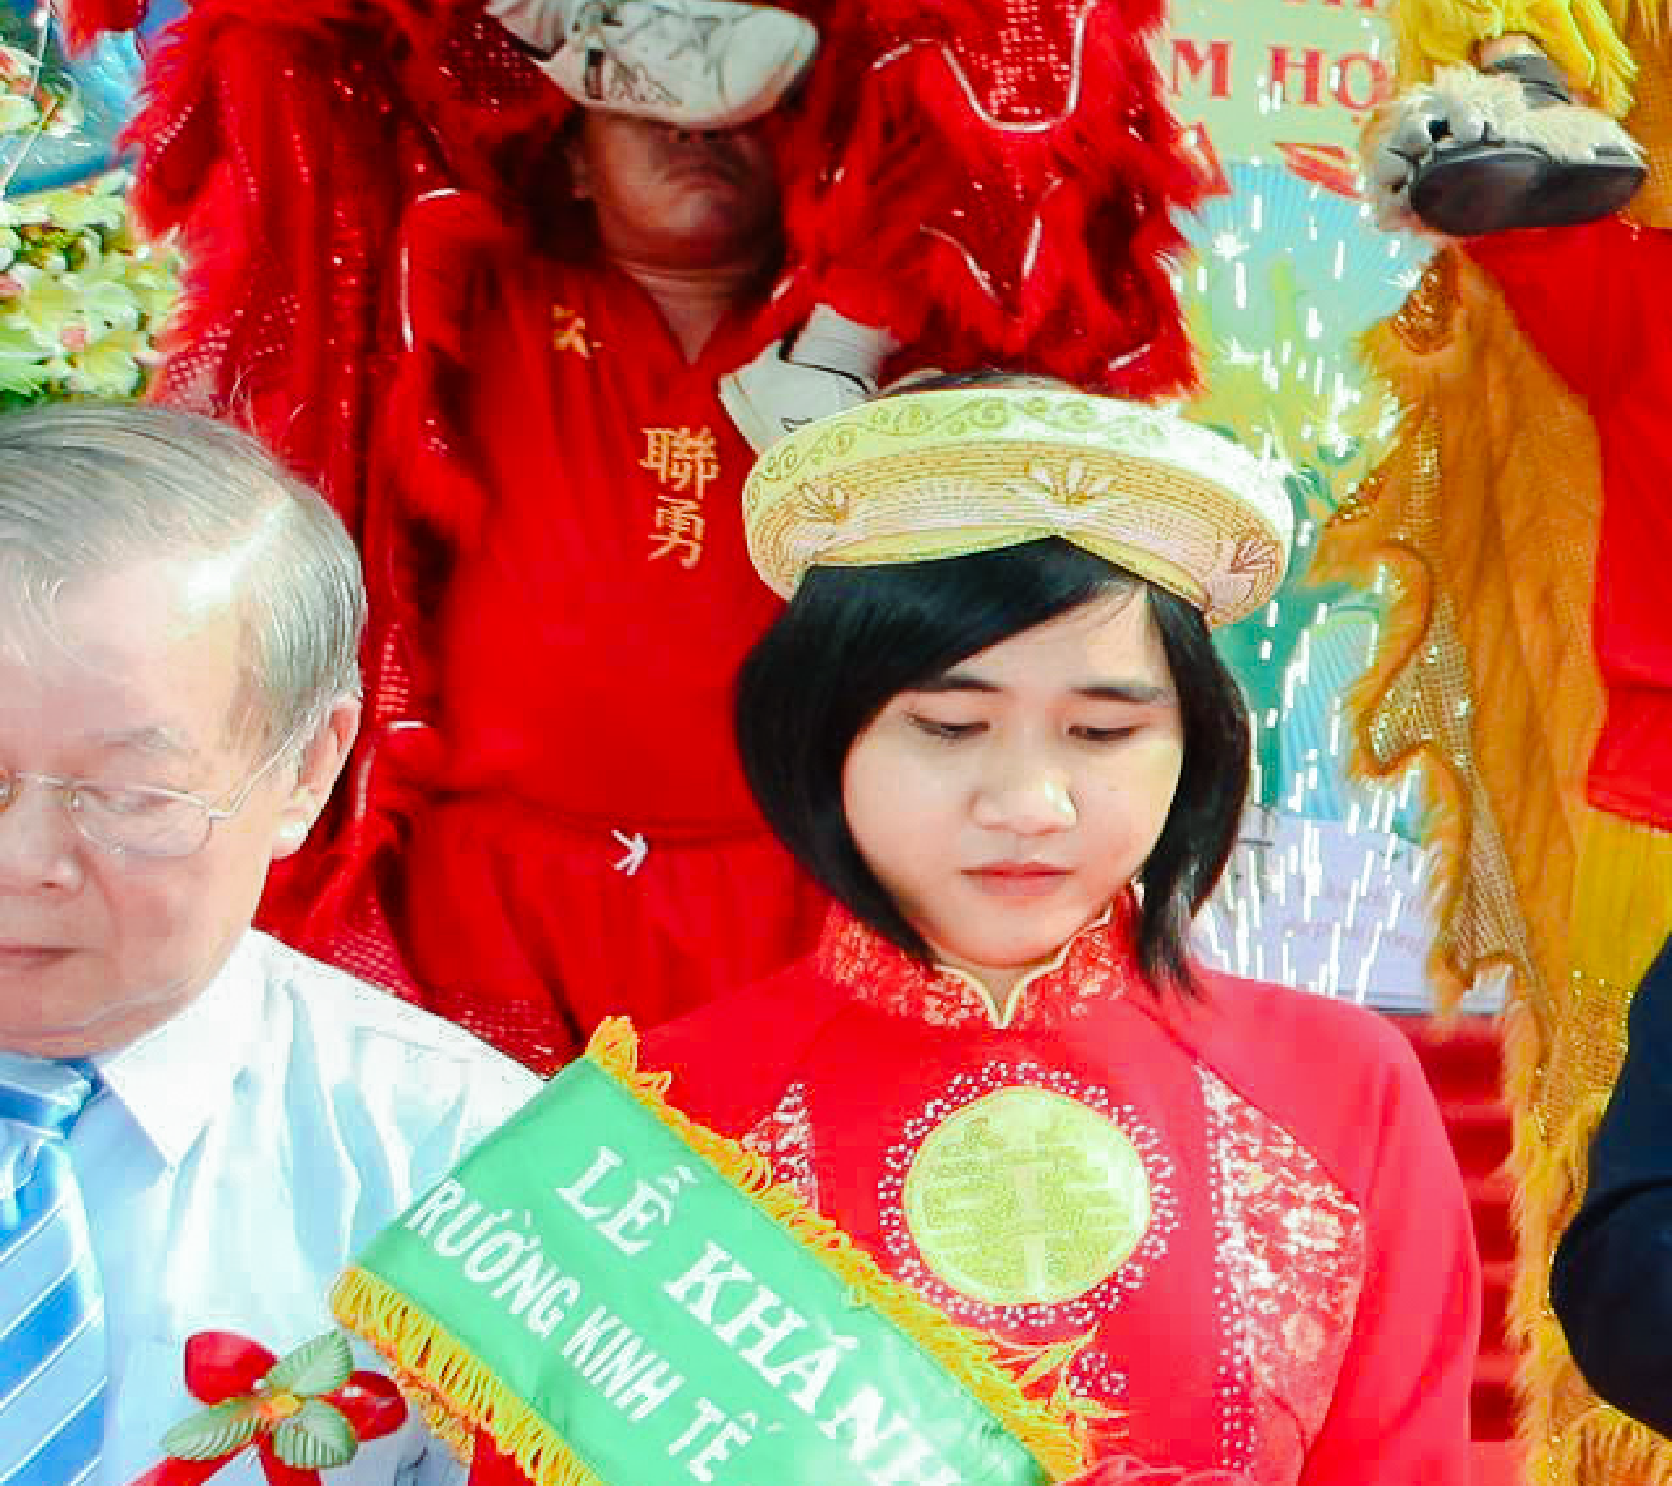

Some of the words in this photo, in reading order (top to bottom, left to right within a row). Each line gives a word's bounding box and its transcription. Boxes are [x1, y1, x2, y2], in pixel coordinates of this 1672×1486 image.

[555, 1145, 700, 1255] LỄ
[561, 1306, 690, 1422] KINH
[667, 1393, 782, 1484] TẾ
